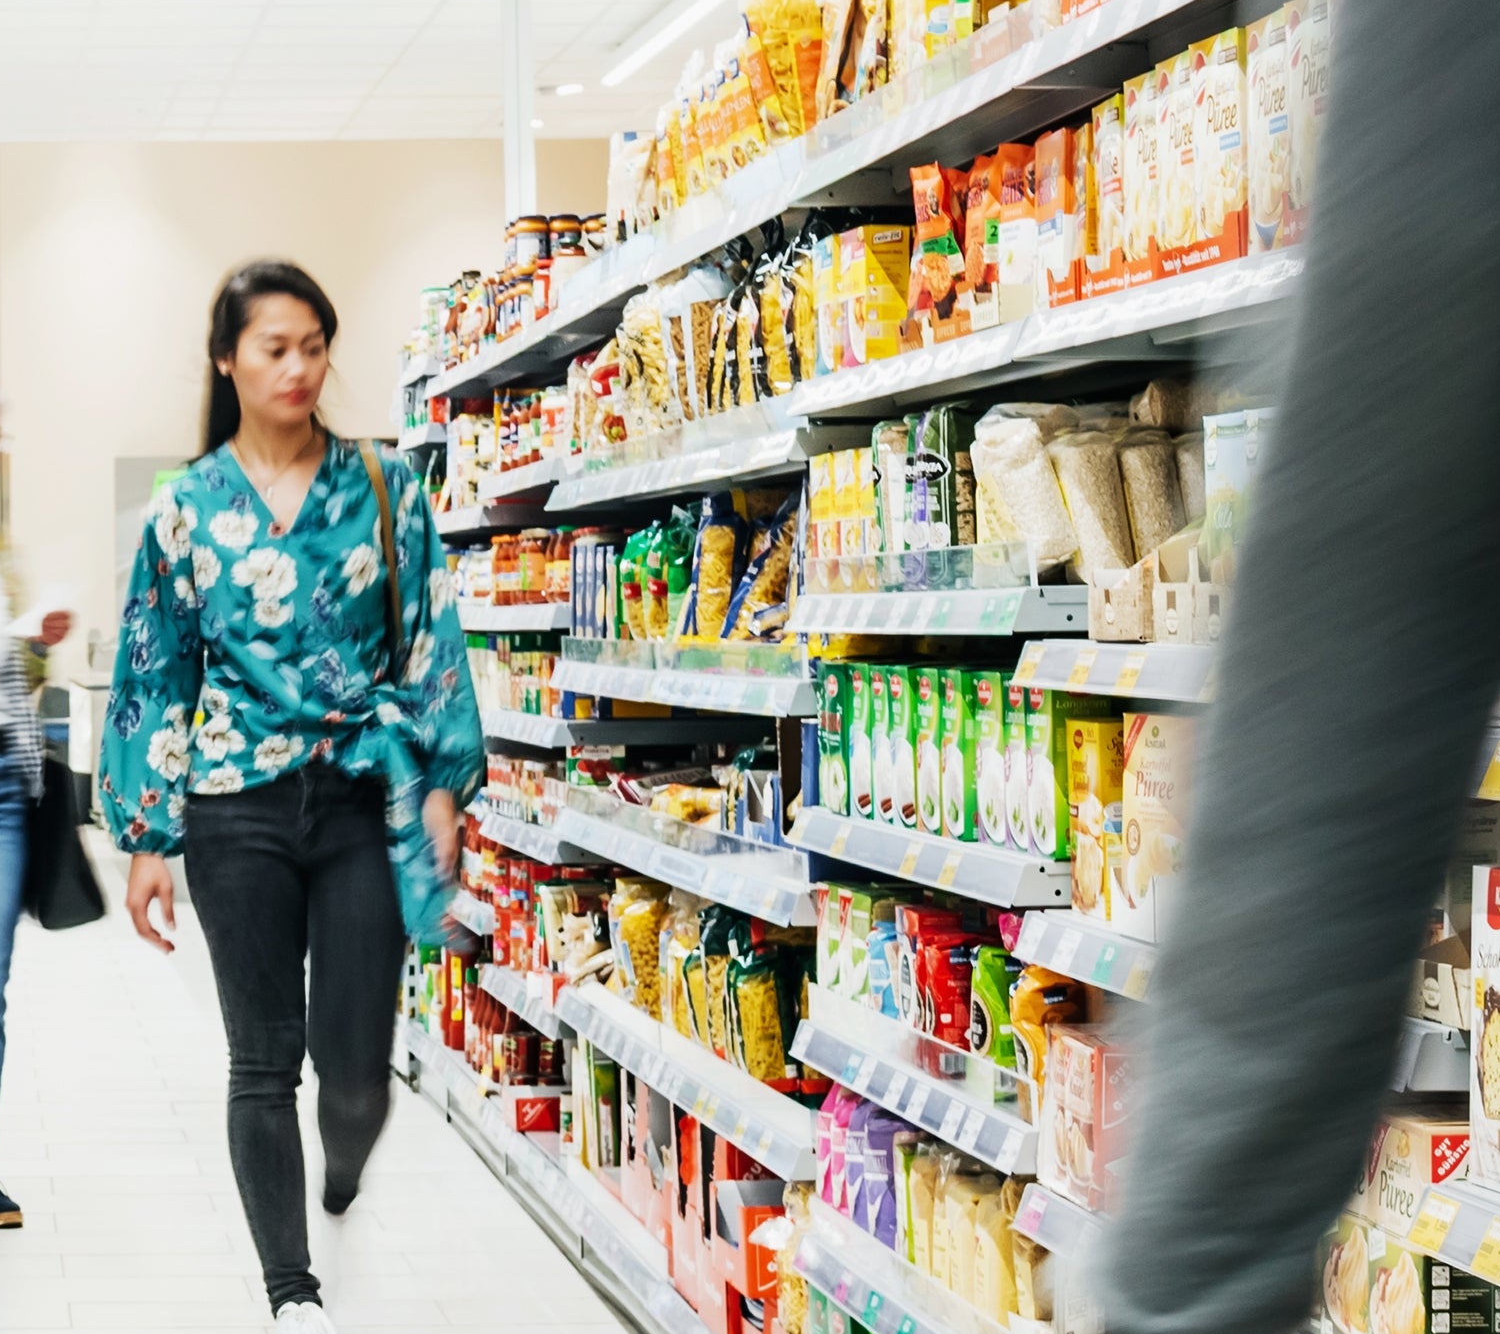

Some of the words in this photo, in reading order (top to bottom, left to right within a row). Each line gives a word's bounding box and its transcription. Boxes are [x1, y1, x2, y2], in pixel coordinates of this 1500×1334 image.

[1207, 93, 1238, 136] Püree
[1258, 76, 1286, 119] Püree
[1136, 770, 1174, 800] Püree
[1433, 1138, 1452, 1157] GUT
[1379, 1173, 1414, 1219] Püree
